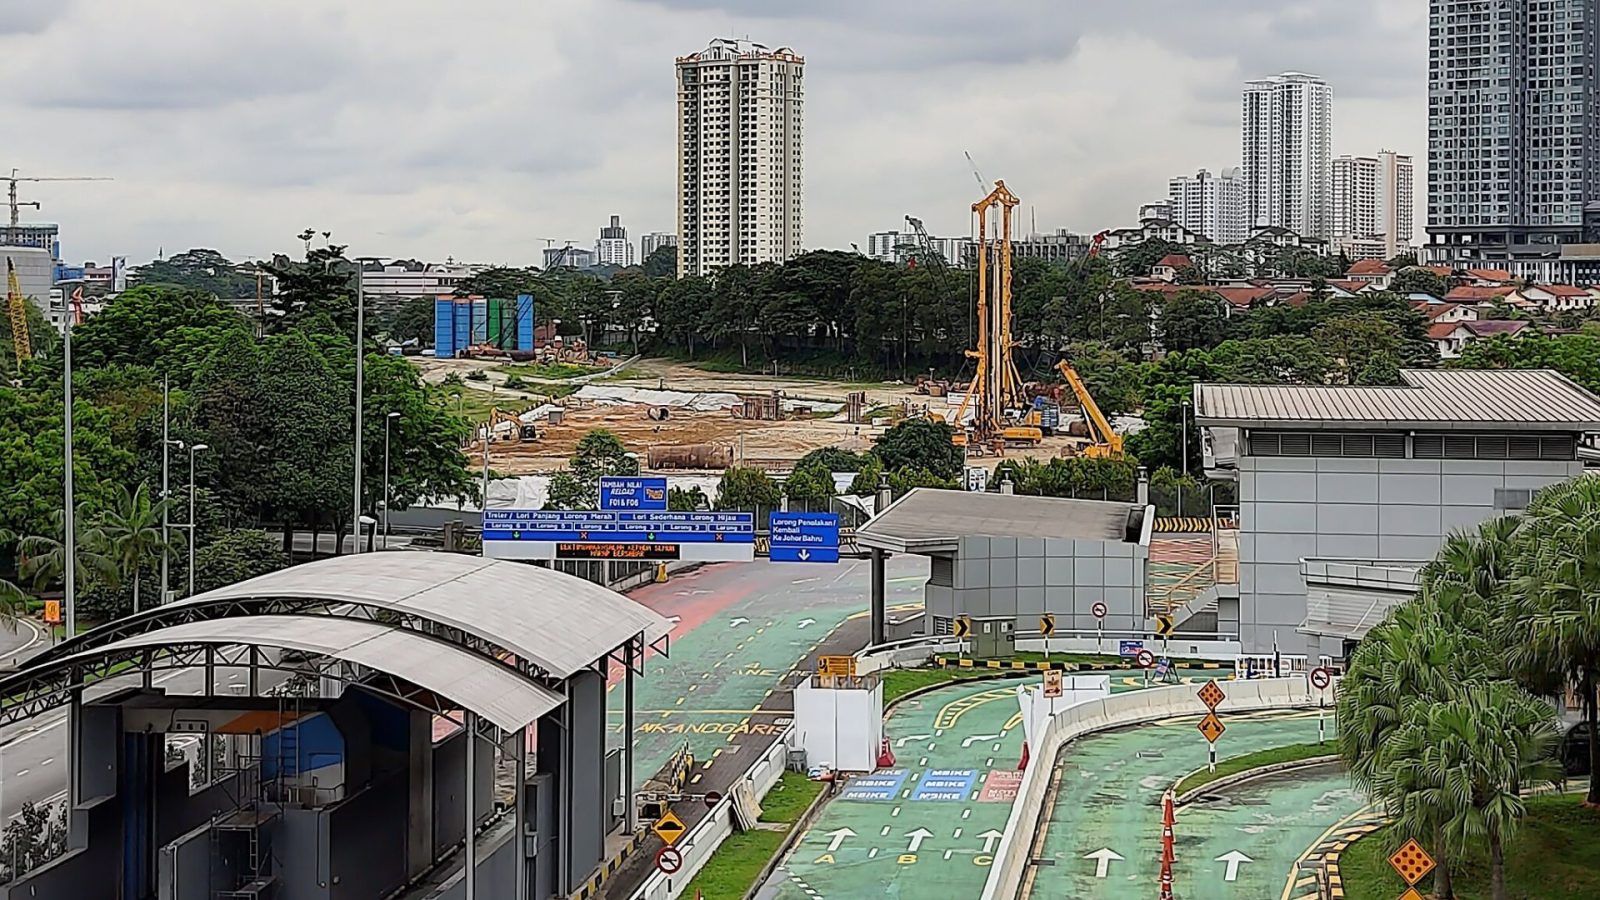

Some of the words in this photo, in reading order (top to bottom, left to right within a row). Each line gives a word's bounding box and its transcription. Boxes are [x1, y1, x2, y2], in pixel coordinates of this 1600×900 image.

[533, 513, 560, 521] Panjang
[564, 513, 587, 521] Lorong
[691, 514, 714, 522] Lorong
[718, 514, 737, 522] Hijau
[773, 518, 797, 527] Lorong
[813, 854, 837, 865] A
[897, 853, 918, 865] B
[973, 854, 993, 866] C
